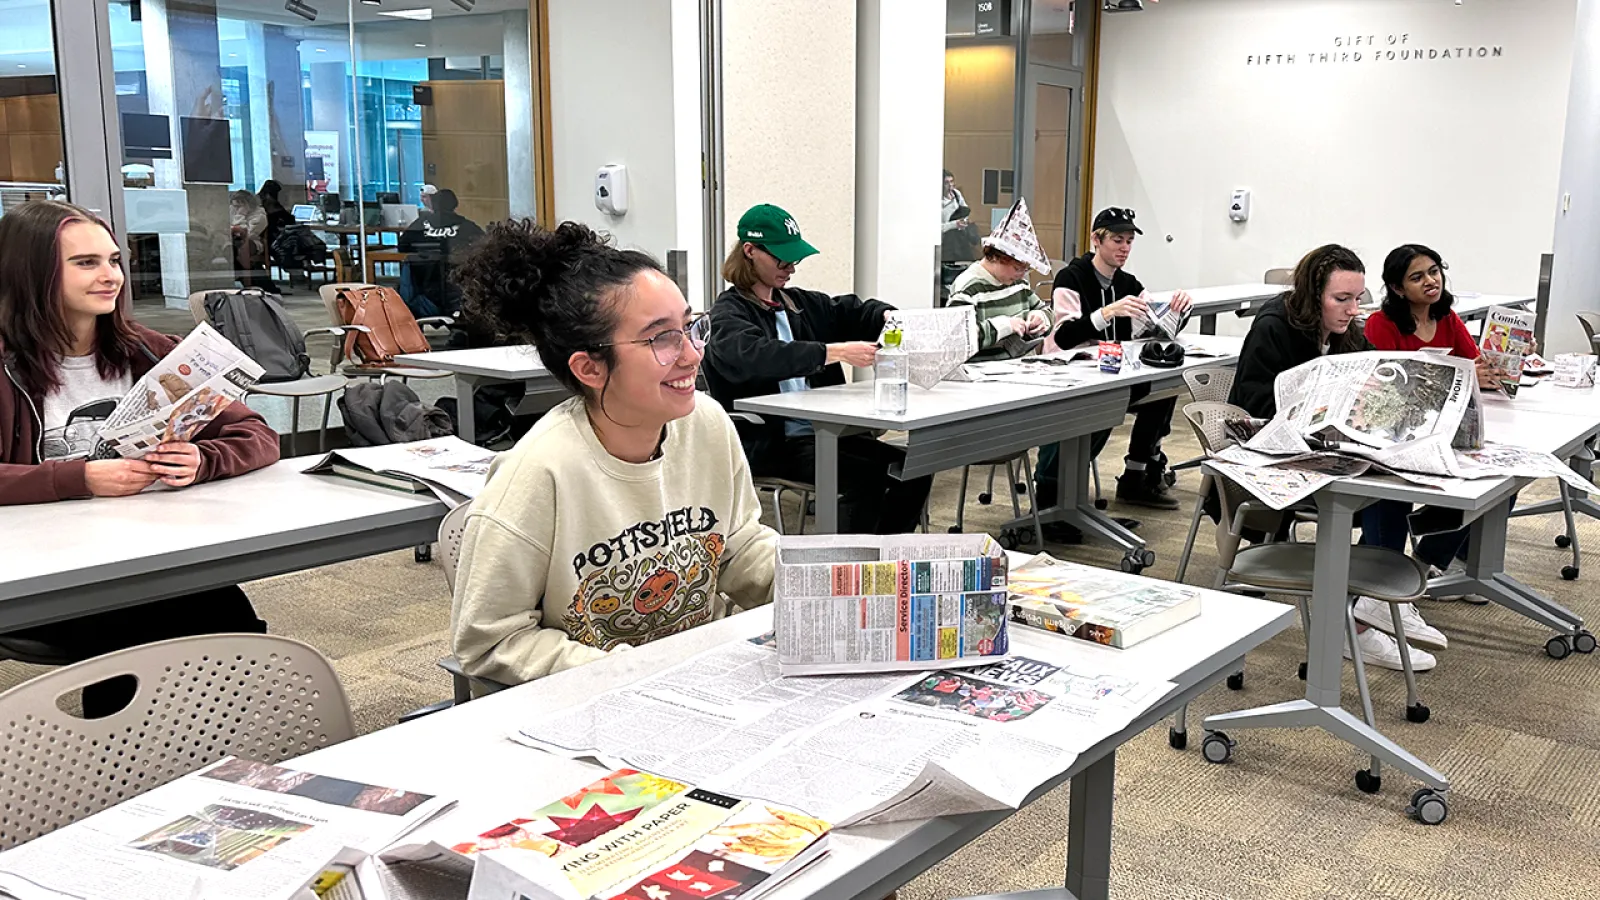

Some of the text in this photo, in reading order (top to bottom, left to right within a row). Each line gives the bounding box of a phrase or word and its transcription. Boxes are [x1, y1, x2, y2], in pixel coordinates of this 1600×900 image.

[1334, 33, 1409, 47] GIFT OF
[1247, 46, 1503, 65] FIFTH THIRD FOUNDATION
[1491, 311, 1528, 328] Comics
[1449, 379, 1463, 403] HOME
[899, 560, 908, 633] Service Director
[560, 851, 600, 874] YING
[600, 828, 644, 853] WITH
[641, 802, 692, 832] PAPER
